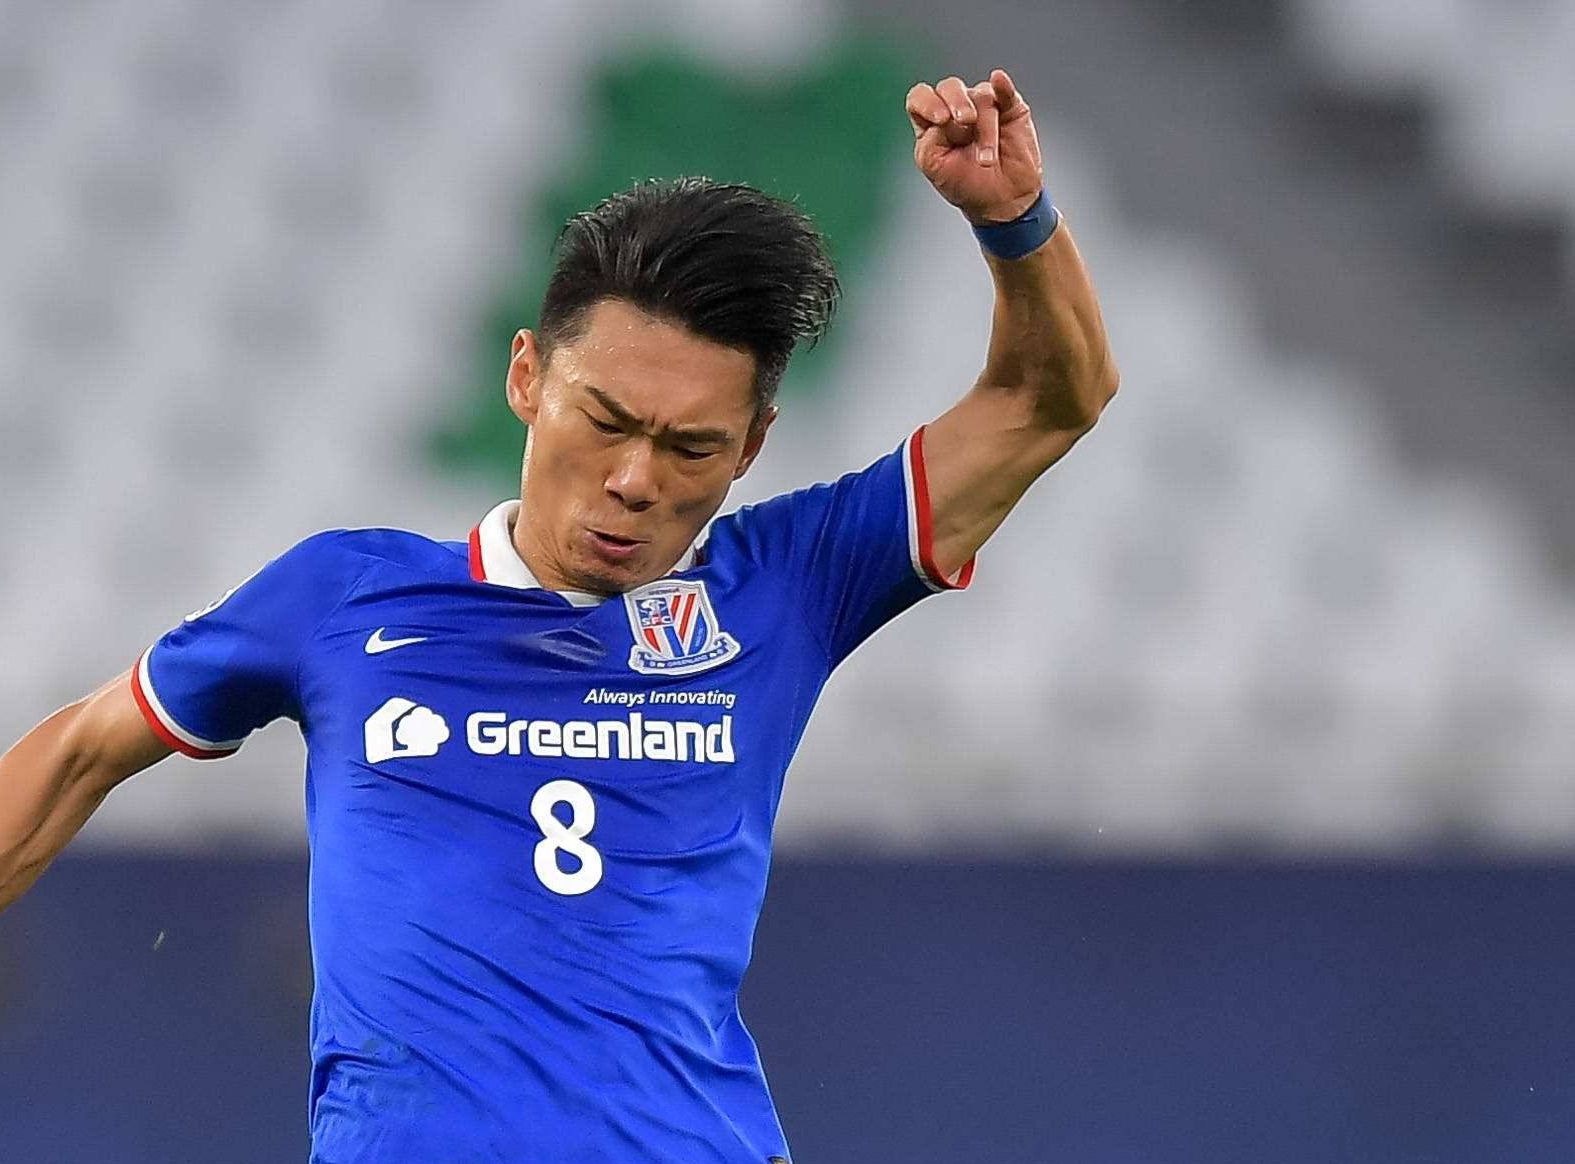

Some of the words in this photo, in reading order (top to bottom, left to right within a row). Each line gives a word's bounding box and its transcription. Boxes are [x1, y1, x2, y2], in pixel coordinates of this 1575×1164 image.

[583, 688, 645, 707] Always
[649, 690, 736, 709] Innovating
[466, 710, 735, 763] Greenland
[530, 779, 603, 896] 8
